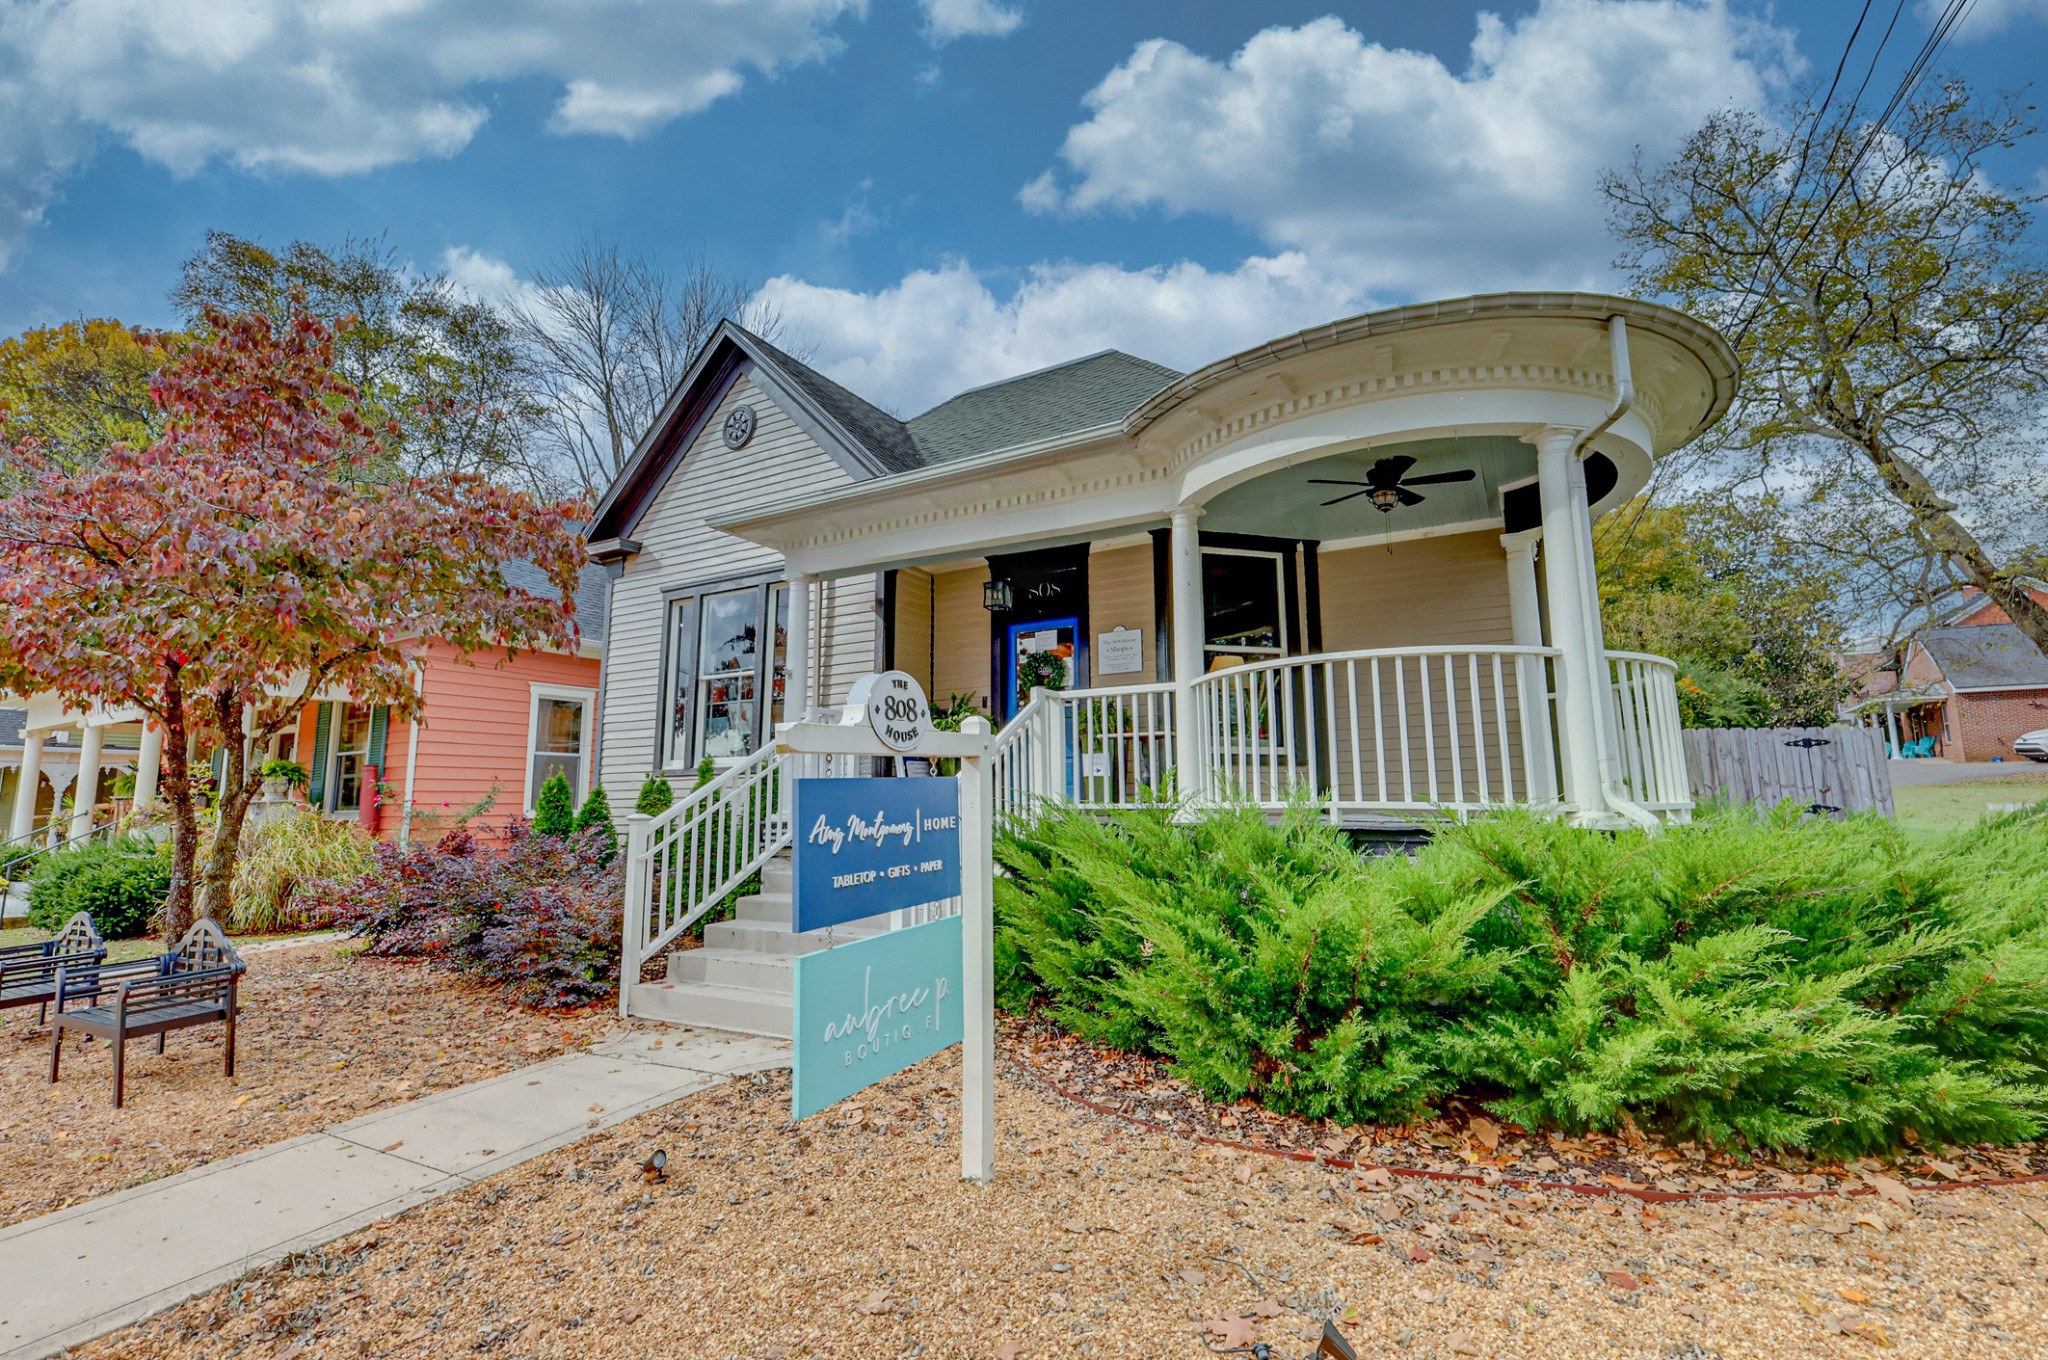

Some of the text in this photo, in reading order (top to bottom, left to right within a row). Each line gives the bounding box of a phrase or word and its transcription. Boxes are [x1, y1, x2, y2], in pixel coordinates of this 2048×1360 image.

[892, 679, 908, 690] THE
[884, 695, 918, 722] 808
[884, 724, 919, 742] HOUSE
[808, 814, 846, 855] Amy
[923, 816, 957, 832] HOME
[831, 859, 943, 889] TABLETOP GIFTS PAPER
[823, 965, 930, 1043] aubree
[844, 1015, 933, 1067] BOUTIQE
